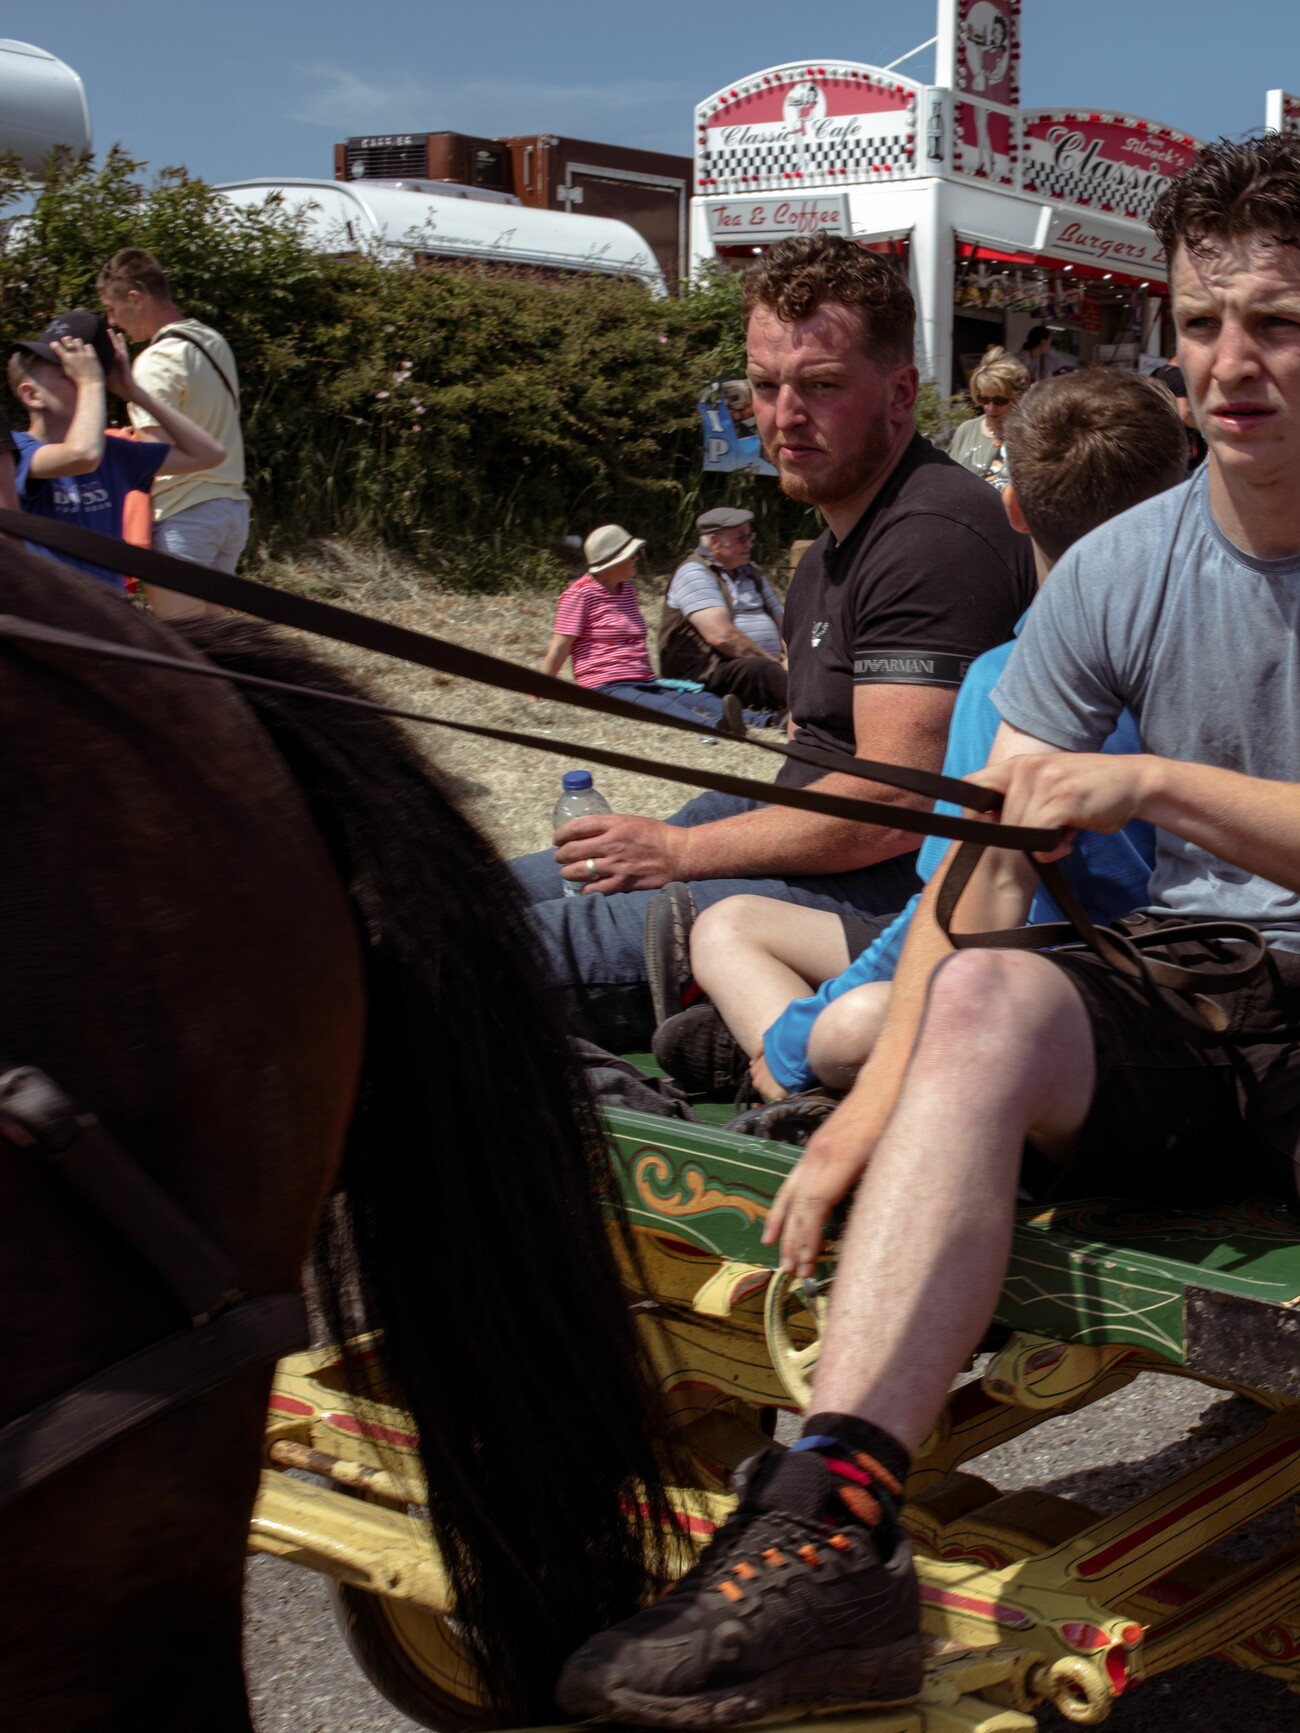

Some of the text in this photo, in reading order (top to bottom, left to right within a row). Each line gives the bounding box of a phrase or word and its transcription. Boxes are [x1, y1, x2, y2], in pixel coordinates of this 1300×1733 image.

[720, 117, 862, 147] Classic Cafe
[1046, 126, 1172, 197] Classic
[712, 201, 840, 233] Tea & Coffee
[1056, 222, 1148, 258] Burgers
[880, 658, 935, 674] ARMANI
